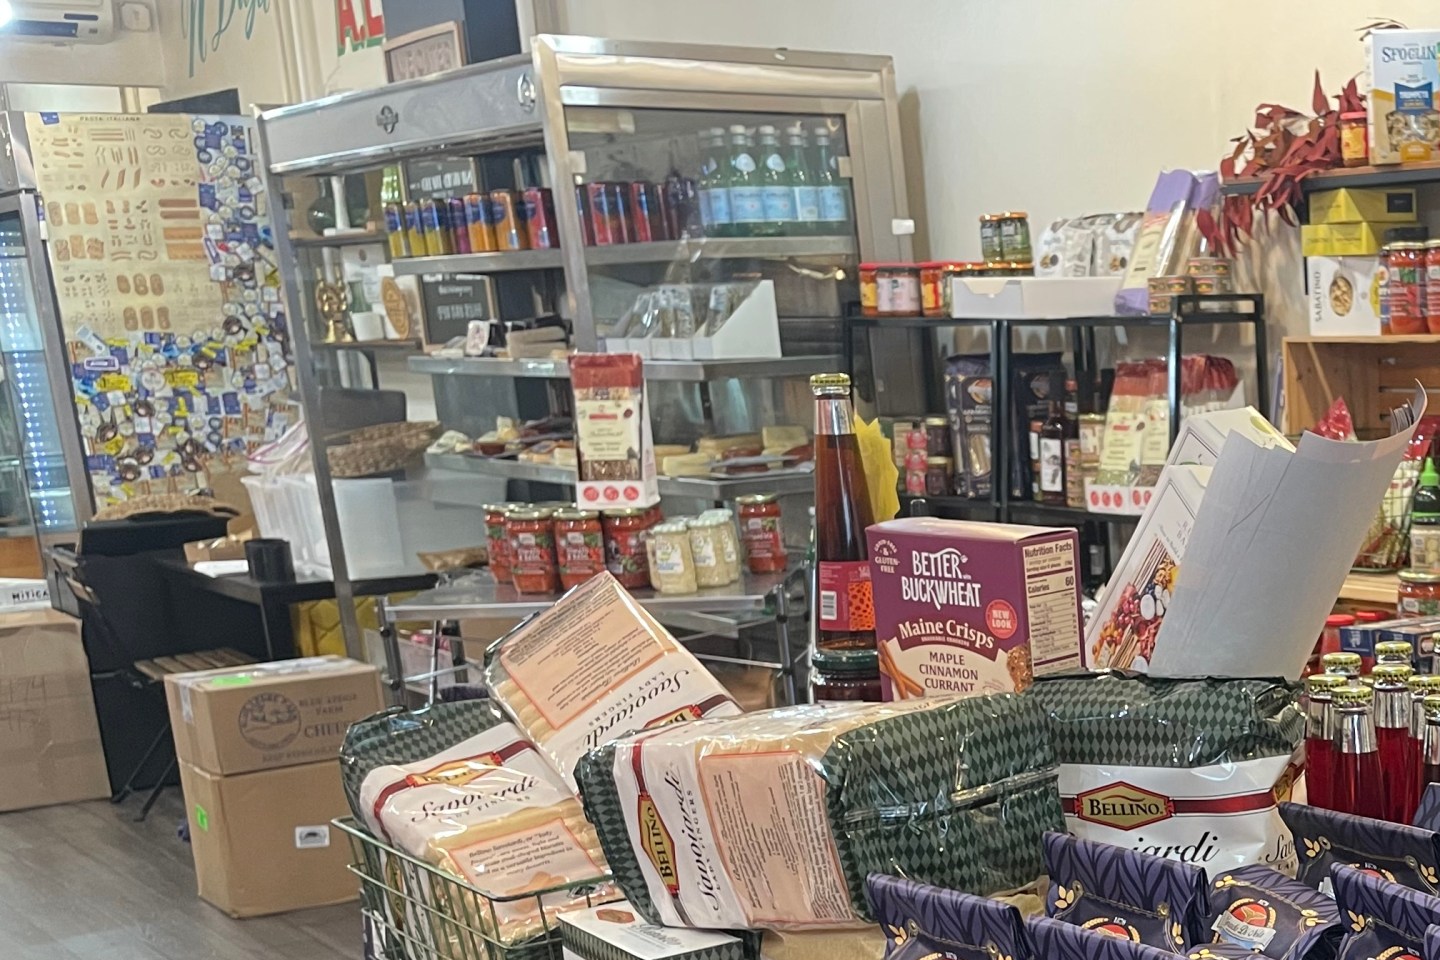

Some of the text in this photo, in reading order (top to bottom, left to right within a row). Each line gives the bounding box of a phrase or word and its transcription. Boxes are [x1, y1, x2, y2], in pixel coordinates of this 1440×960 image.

[1381, 46, 1437, 63] SFOGLIN
[1314, 271, 1322, 323] SABATINO
[1025, 541, 1072, 559] Nutrition Facts
[912, 548, 962, 579] BETTER
[901, 576, 981, 611] BUCKWHEAT
[1027, 584, 1050, 594] Calories
[992, 609, 1010, 619] NEW
[991, 618, 1012, 629] LOOK
[898, 619, 943, 640] Maine
[945, 620, 995, 649] Crisps
[929, 651, 965, 666] MAPLE
[919, 664, 978, 680] CINNAMON
[924, 678, 975, 693] CURRANT
[1089, 798, 1161, 817] BELLINO
[646, 806, 673, 878] BELLINO
[664, 770, 721, 911] Savoiardi
